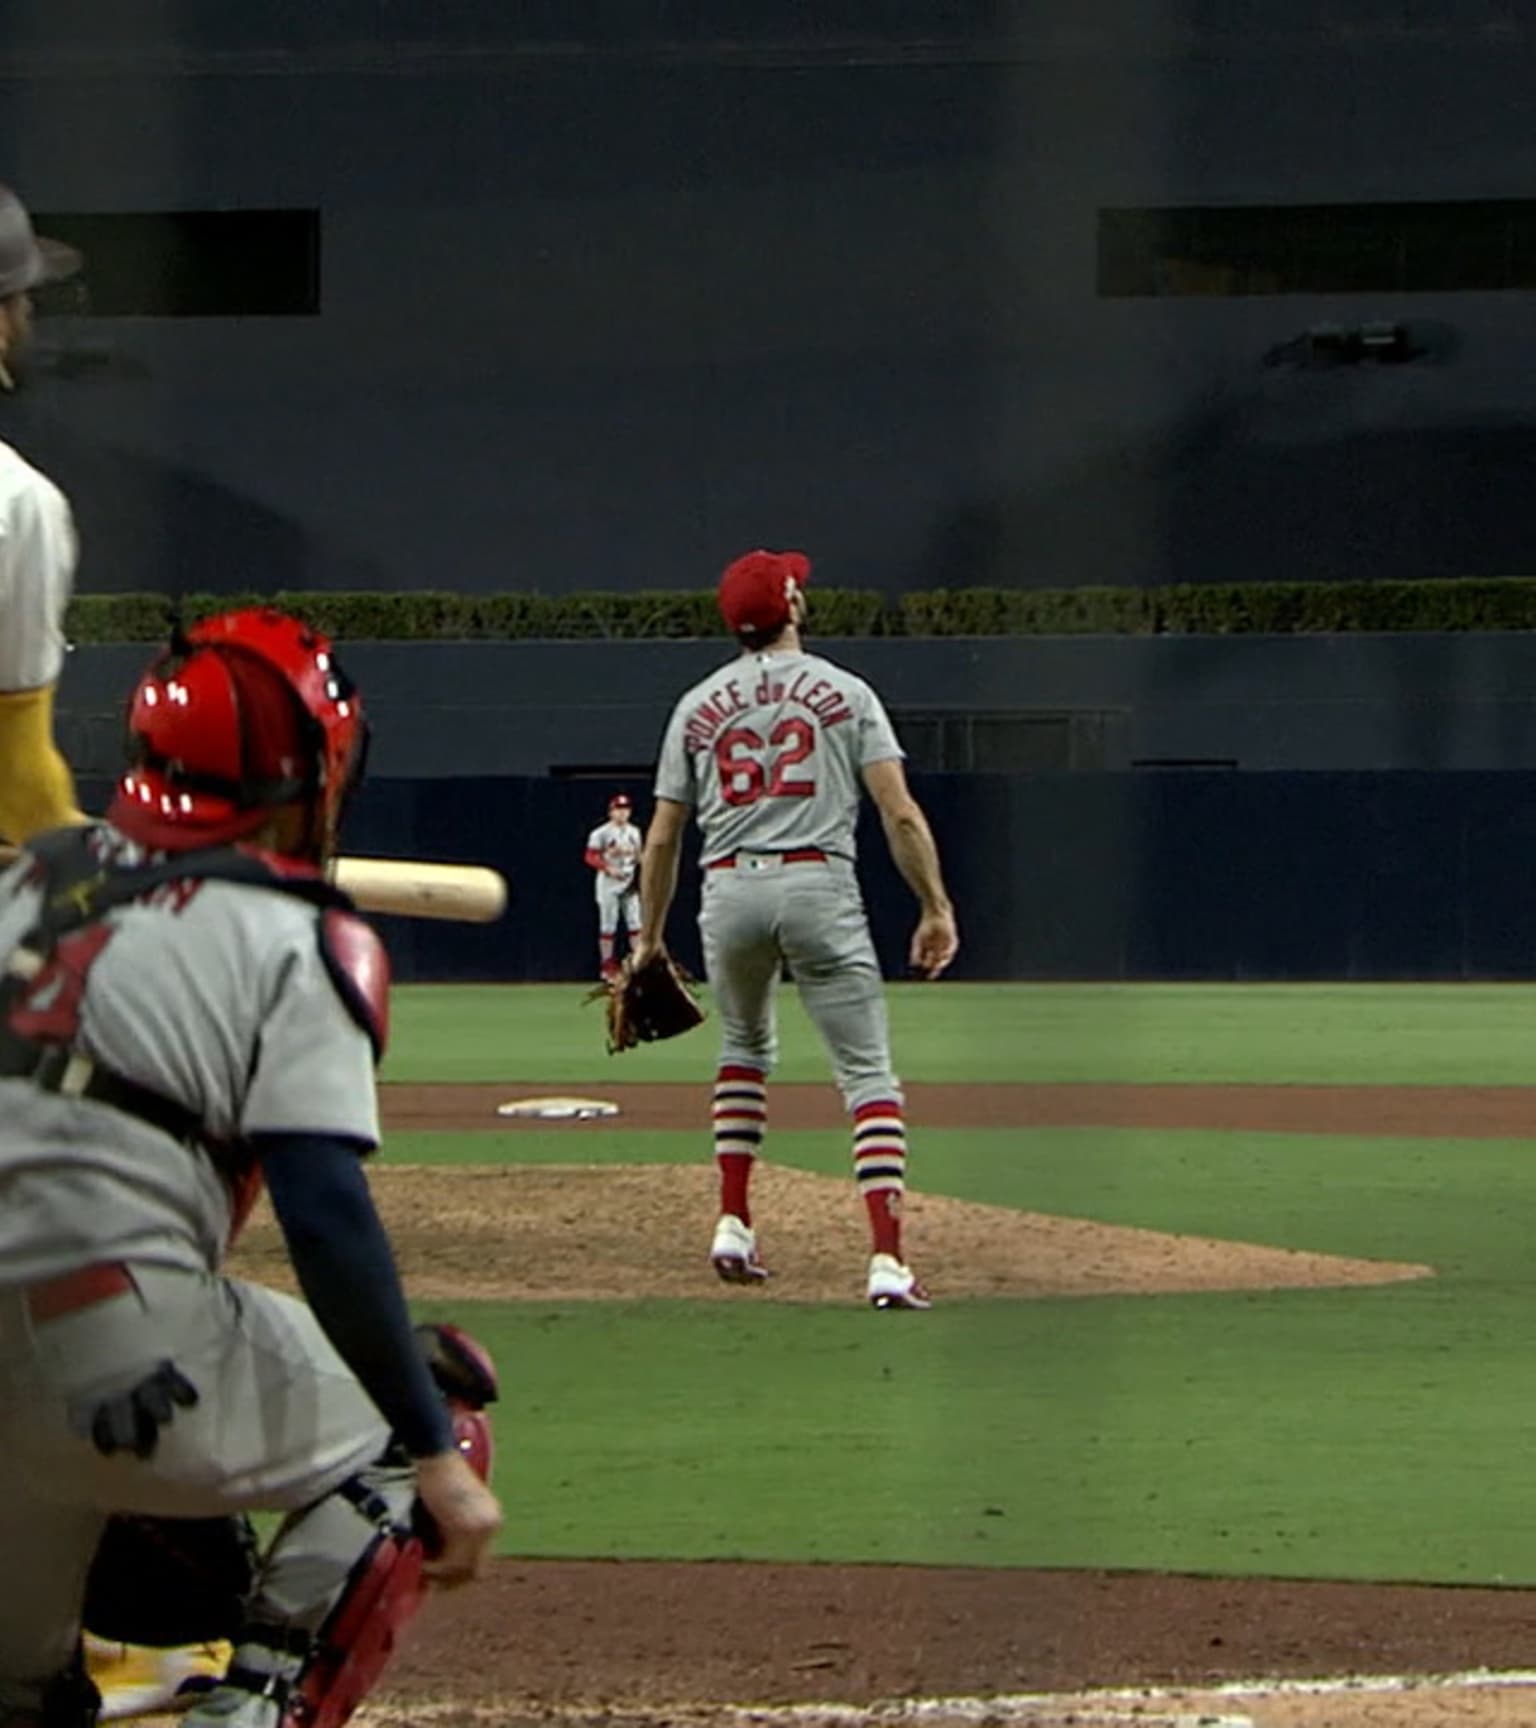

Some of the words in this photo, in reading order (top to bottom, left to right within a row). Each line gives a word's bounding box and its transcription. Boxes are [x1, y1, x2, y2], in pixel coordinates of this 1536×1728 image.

[684, 679, 750, 754] PONCE
[789, 670, 854, 730] LEON
[715, 717, 816, 806] 62
